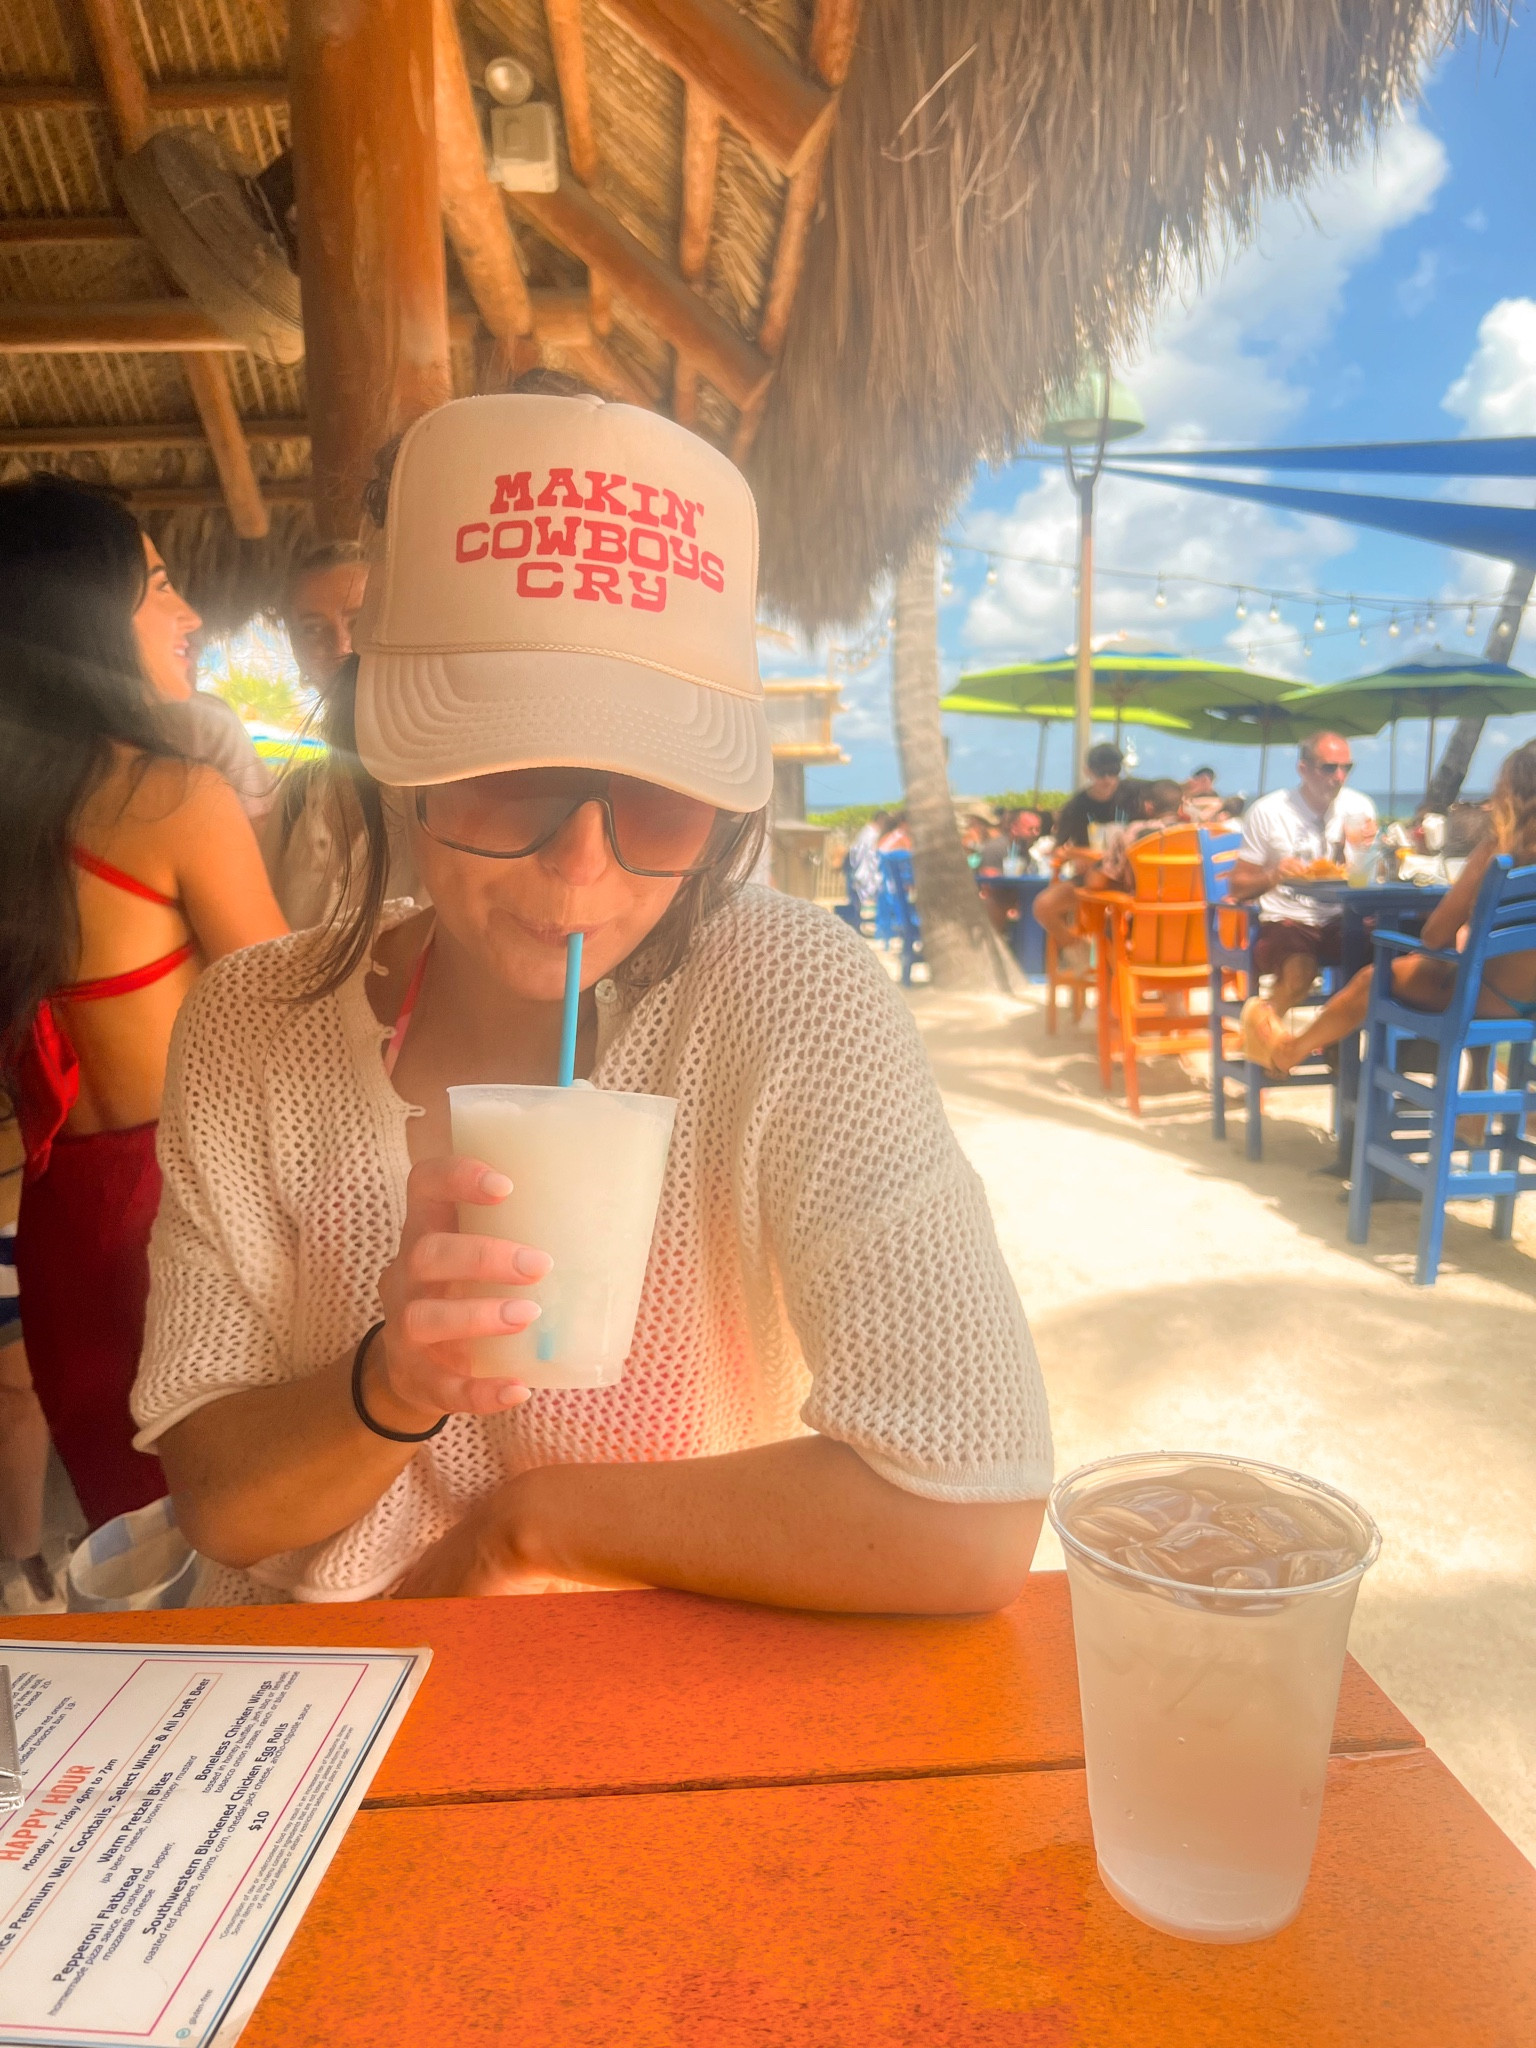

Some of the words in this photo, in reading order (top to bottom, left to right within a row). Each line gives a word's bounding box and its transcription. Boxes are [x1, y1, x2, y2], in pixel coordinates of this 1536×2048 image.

[490, 468, 704, 538] MAKIN'
[456, 516, 724, 593] COWBOYS
[517, 562, 666, 612] CRY
[53, 1713, 67, 1724] bun
[195, 1740, 231, 1781] Boneless
[225, 1706, 254, 1738] Chicken
[248, 1680, 272, 1704] Wings
[214, 1768, 235, 1793] tobacco
[234, 1750, 248, 1768] onion
[260, 1711, 273, 1727] ranch
[275, 1691, 286, 1703] blue
[0, 1808, 58, 1861] HAPPY
[42, 1765, 95, 1804] HOUR
[9, 1882, 56, 1929] Premium
[48, 1857, 75, 1878] Well
[70, 1805, 116, 1852] Cocktails,
[109, 1772, 140, 1801] Select
[132, 1744, 160, 1769] Wines
[163, 1721, 179, 1731] All
[173, 1698, 196, 1718] Draft
[190, 1679, 210, 1695] Beer
[22, 1839, 54, 1871] Monday
[55, 1806, 81, 1829] Friday
[77, 1787, 95, 1803] 4pm
[99, 1759, 118, 1774] 7pm
[110, 1855, 126, 1870] beer
[124, 1826, 148, 1852] cheese,
[143, 1803, 163, 1824] brown
[159, 1782, 179, 1801] honey
[176, 1755, 197, 1780] mustard
[202, 1772, 221, 1793] tossed
[223, 1745, 241, 1763] honey
[97, 1835, 127, 1863] Warm
[121, 1799, 154, 1831] Pretzel
[147, 1772, 173, 1795] Bites
[143, 1858, 202, 1935] Southwestern
[194, 1804, 237, 1855] Blackened
[230, 1765, 262, 1801] Chicken
[254, 1746, 278, 1762] Egg
[267, 1723, 289, 1743] Rolls
[143, 1933, 167, 1964] roasted
[164, 1918, 177, 1931] red
[174, 1884, 200, 1916] peppers,
[197, 1855, 219, 1881] onions,
[215, 1836, 231, 1853] corn,
[254, 1766, 275, 1791] cheese,
[298, 1703, 312, 1720] sauce
[248, 1811, 269, 1831] $10
[52, 1924, 104, 1982] Pepperoni
[97, 1868, 143, 1919] Flatbread
[85, 1944, 103, 1965] pizza
[101, 1918, 124, 1943] sauce,
[121, 1884, 145, 1914] crushed
[143, 1870, 155, 1882] red
[152, 1842, 176, 1869] pepper,
[103, 1919, 135, 1961] mozzarella
[133, 1888, 155, 1916] cheese
[266, 1879, 277, 1891] food
